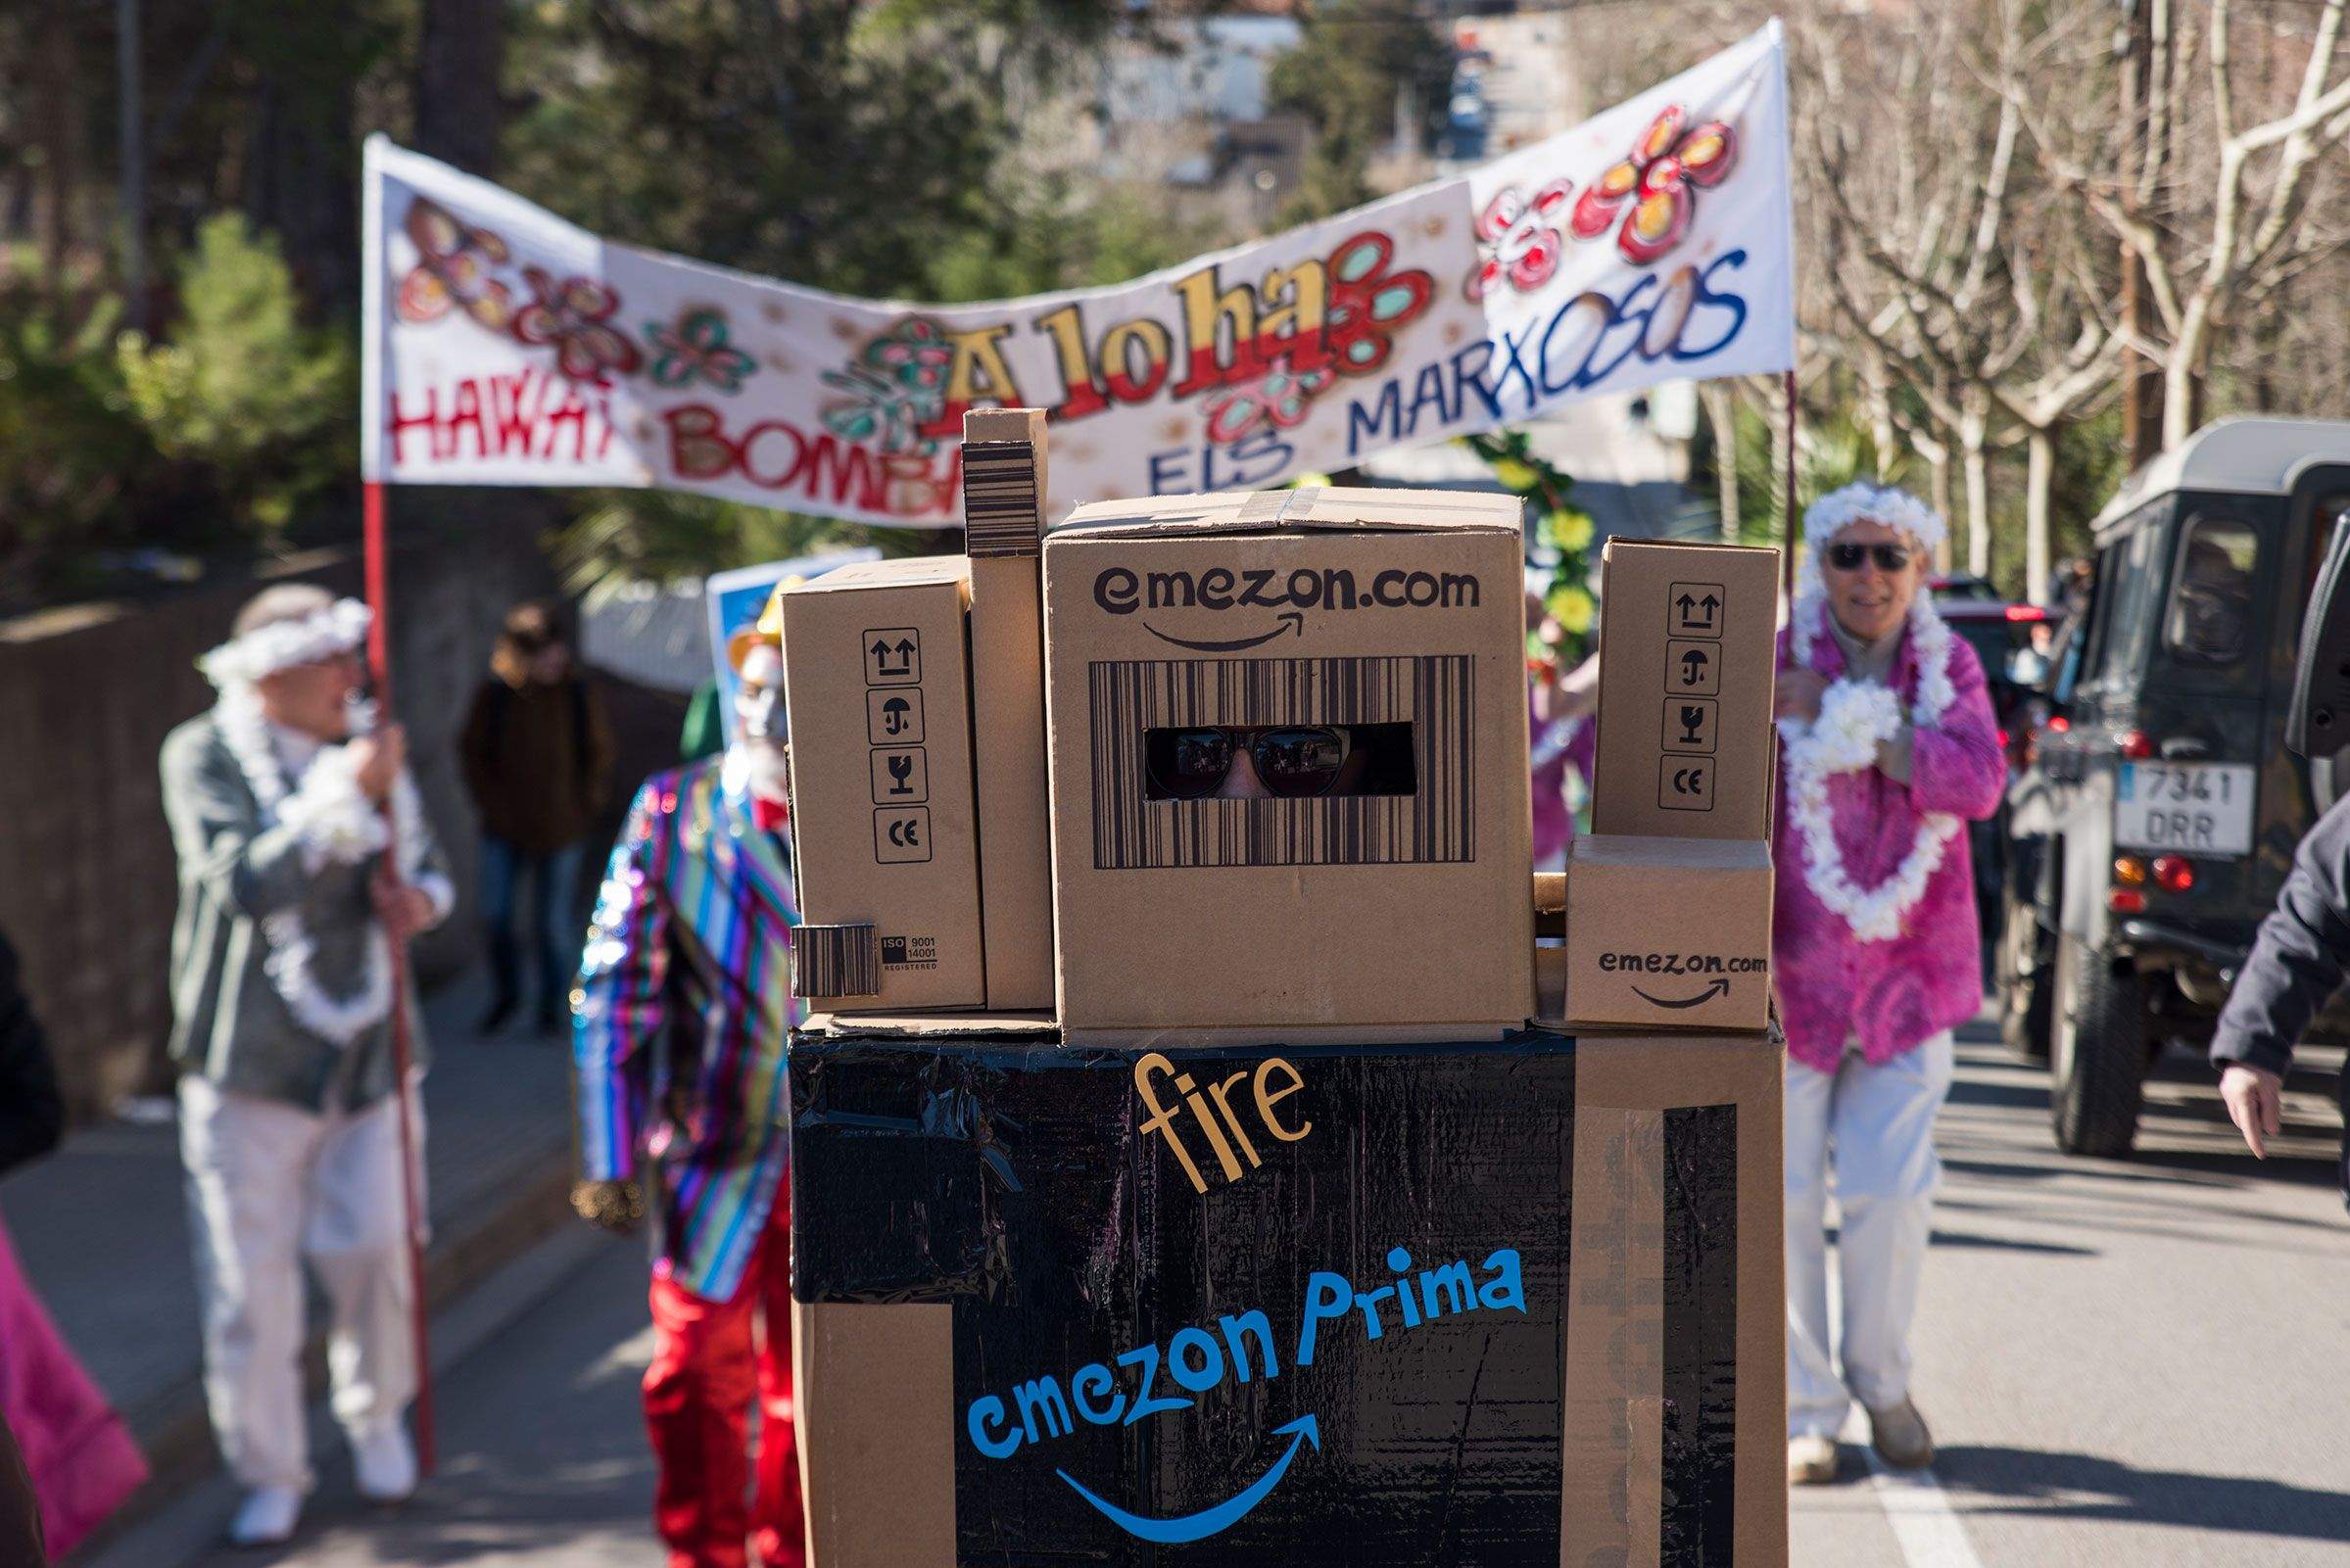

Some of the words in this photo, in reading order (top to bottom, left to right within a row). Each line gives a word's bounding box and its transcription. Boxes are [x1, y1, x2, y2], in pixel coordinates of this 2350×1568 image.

[920, 261, 1340, 440] Aloha
[1149, 430, 1295, 496] ELS
[1348, 249, 1748, 456] MARXOSOS
[1093, 566, 1481, 615] emezon.com
[2147, 768, 2231, 805] 7341
[883, 938, 905, 949] ISO
[911, 937, 935, 948] 9001
[907, 948, 936, 959] 14001
[1598, 952, 1768, 975] emezon.com
[884, 963, 937, 972] REGISTERED
[1133, 1051, 1314, 1196] fire
[967, 1308, 1279, 1459] emezon
[1296, 1246, 1527, 1366] Prima
